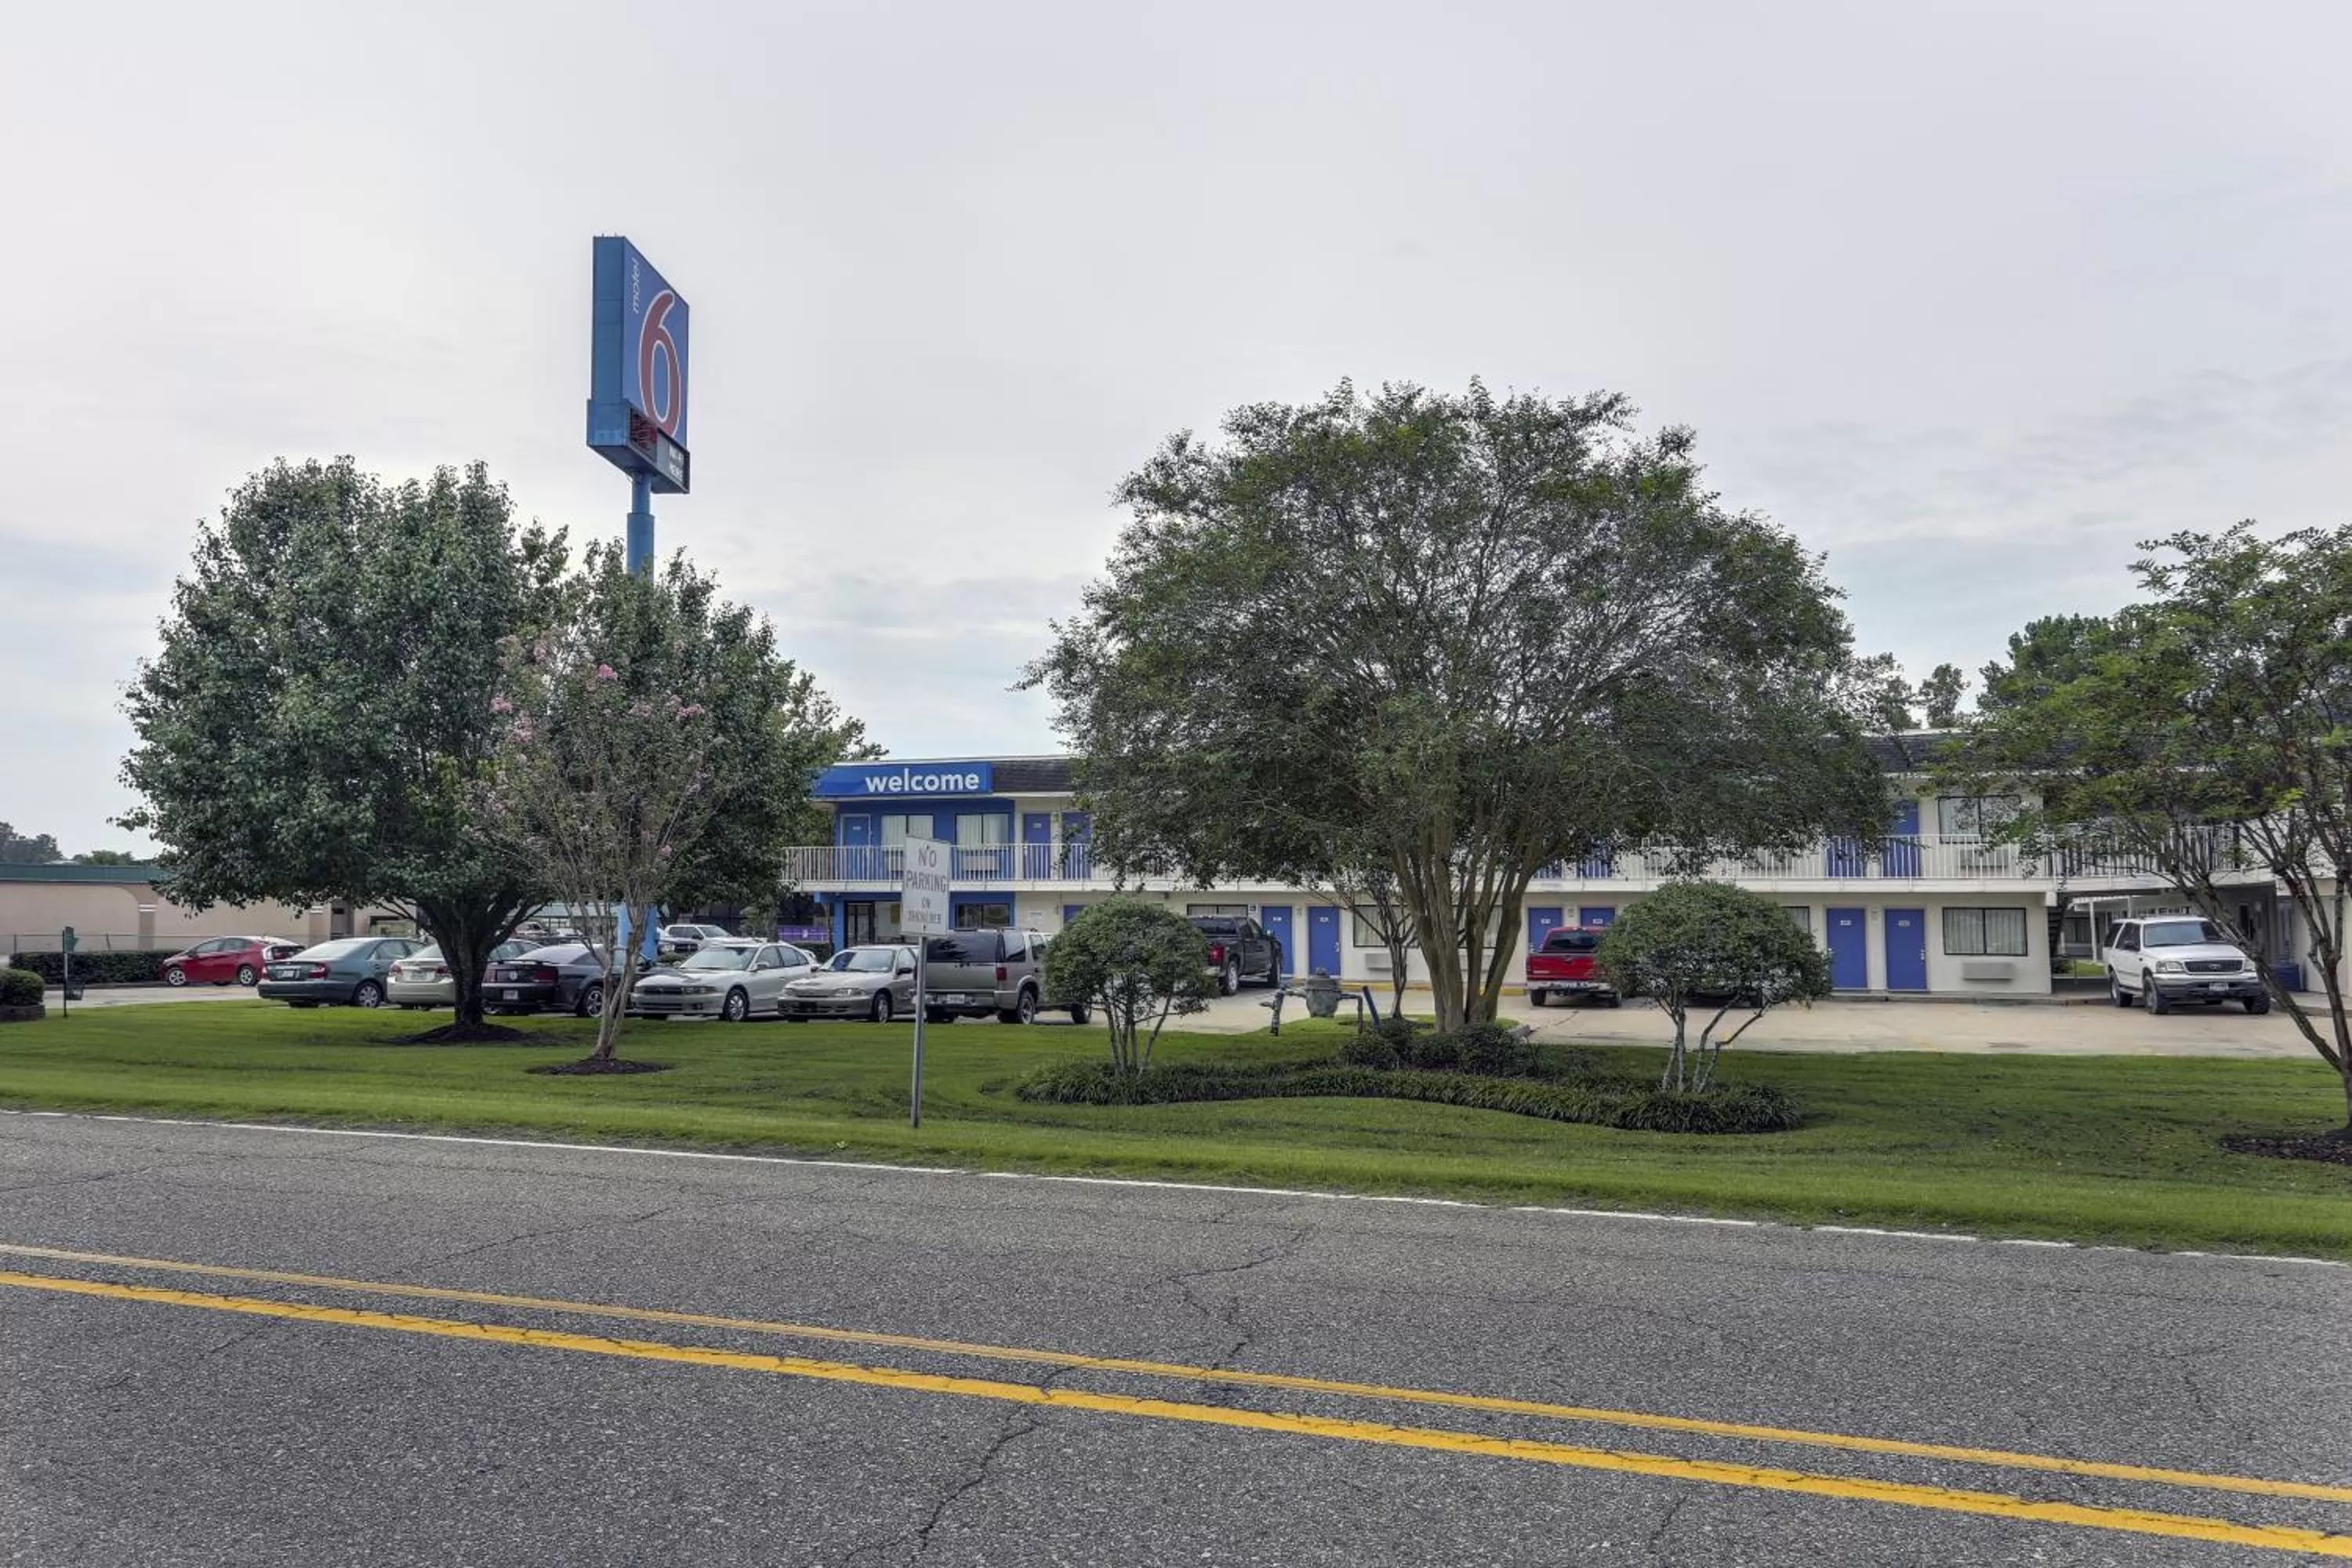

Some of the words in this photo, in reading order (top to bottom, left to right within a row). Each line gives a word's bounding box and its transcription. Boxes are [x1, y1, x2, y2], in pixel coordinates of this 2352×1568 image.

[639, 289, 681, 437] 6
[865, 768, 979, 793] welcome
[918, 849, 937, 867] NO
[906, 870, 948, 893] PARKING
